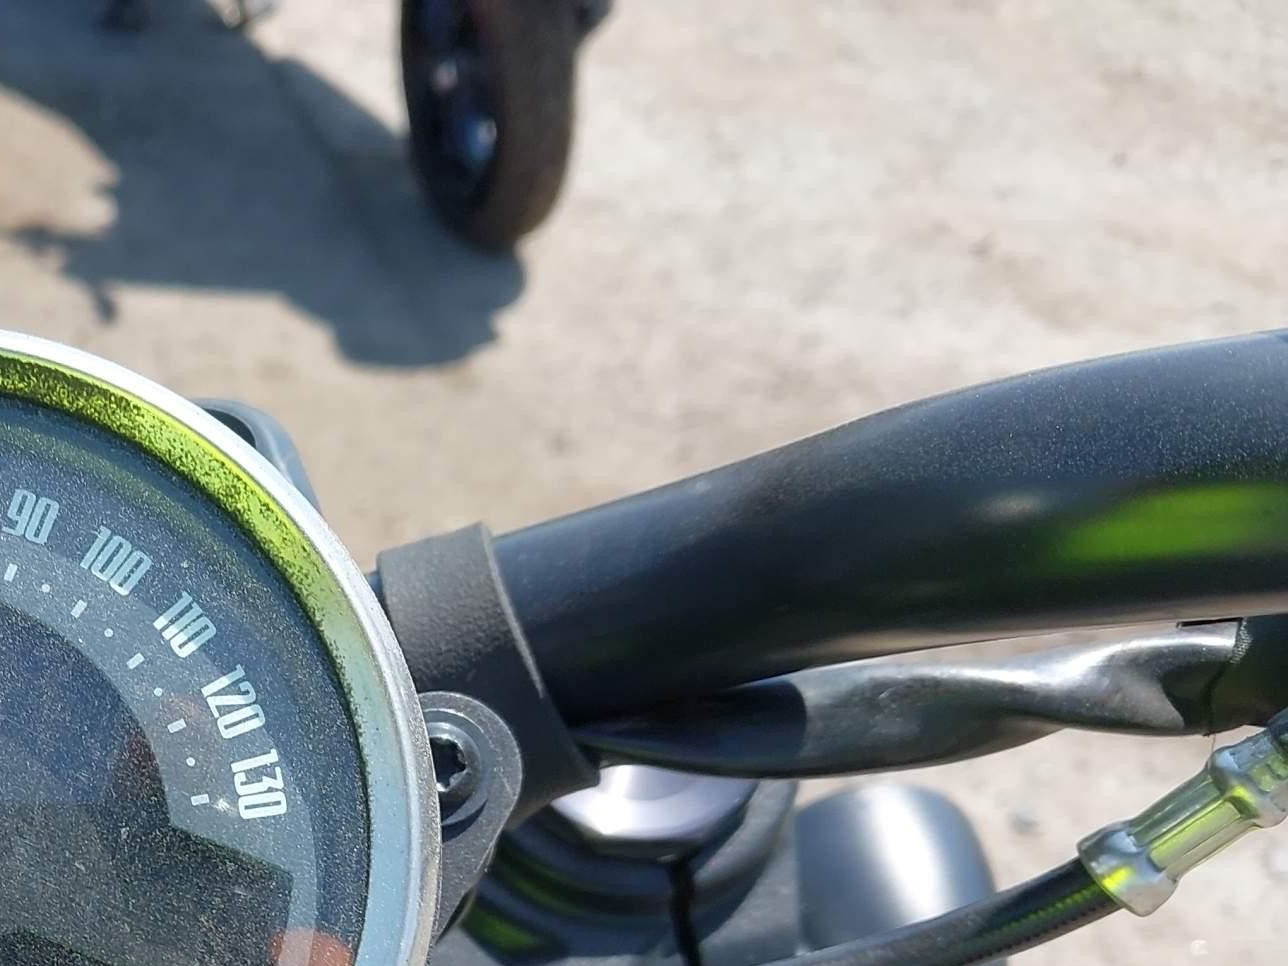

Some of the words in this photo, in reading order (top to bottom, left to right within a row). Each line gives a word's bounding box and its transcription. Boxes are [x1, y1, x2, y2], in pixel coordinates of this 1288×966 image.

[2, 489, 60, 545] 90
[79, 527, 152, 596] 100
[153, 592, 217, 658] 110
[201, 664, 266, 739] 120
[231, 749, 287, 820] 130
